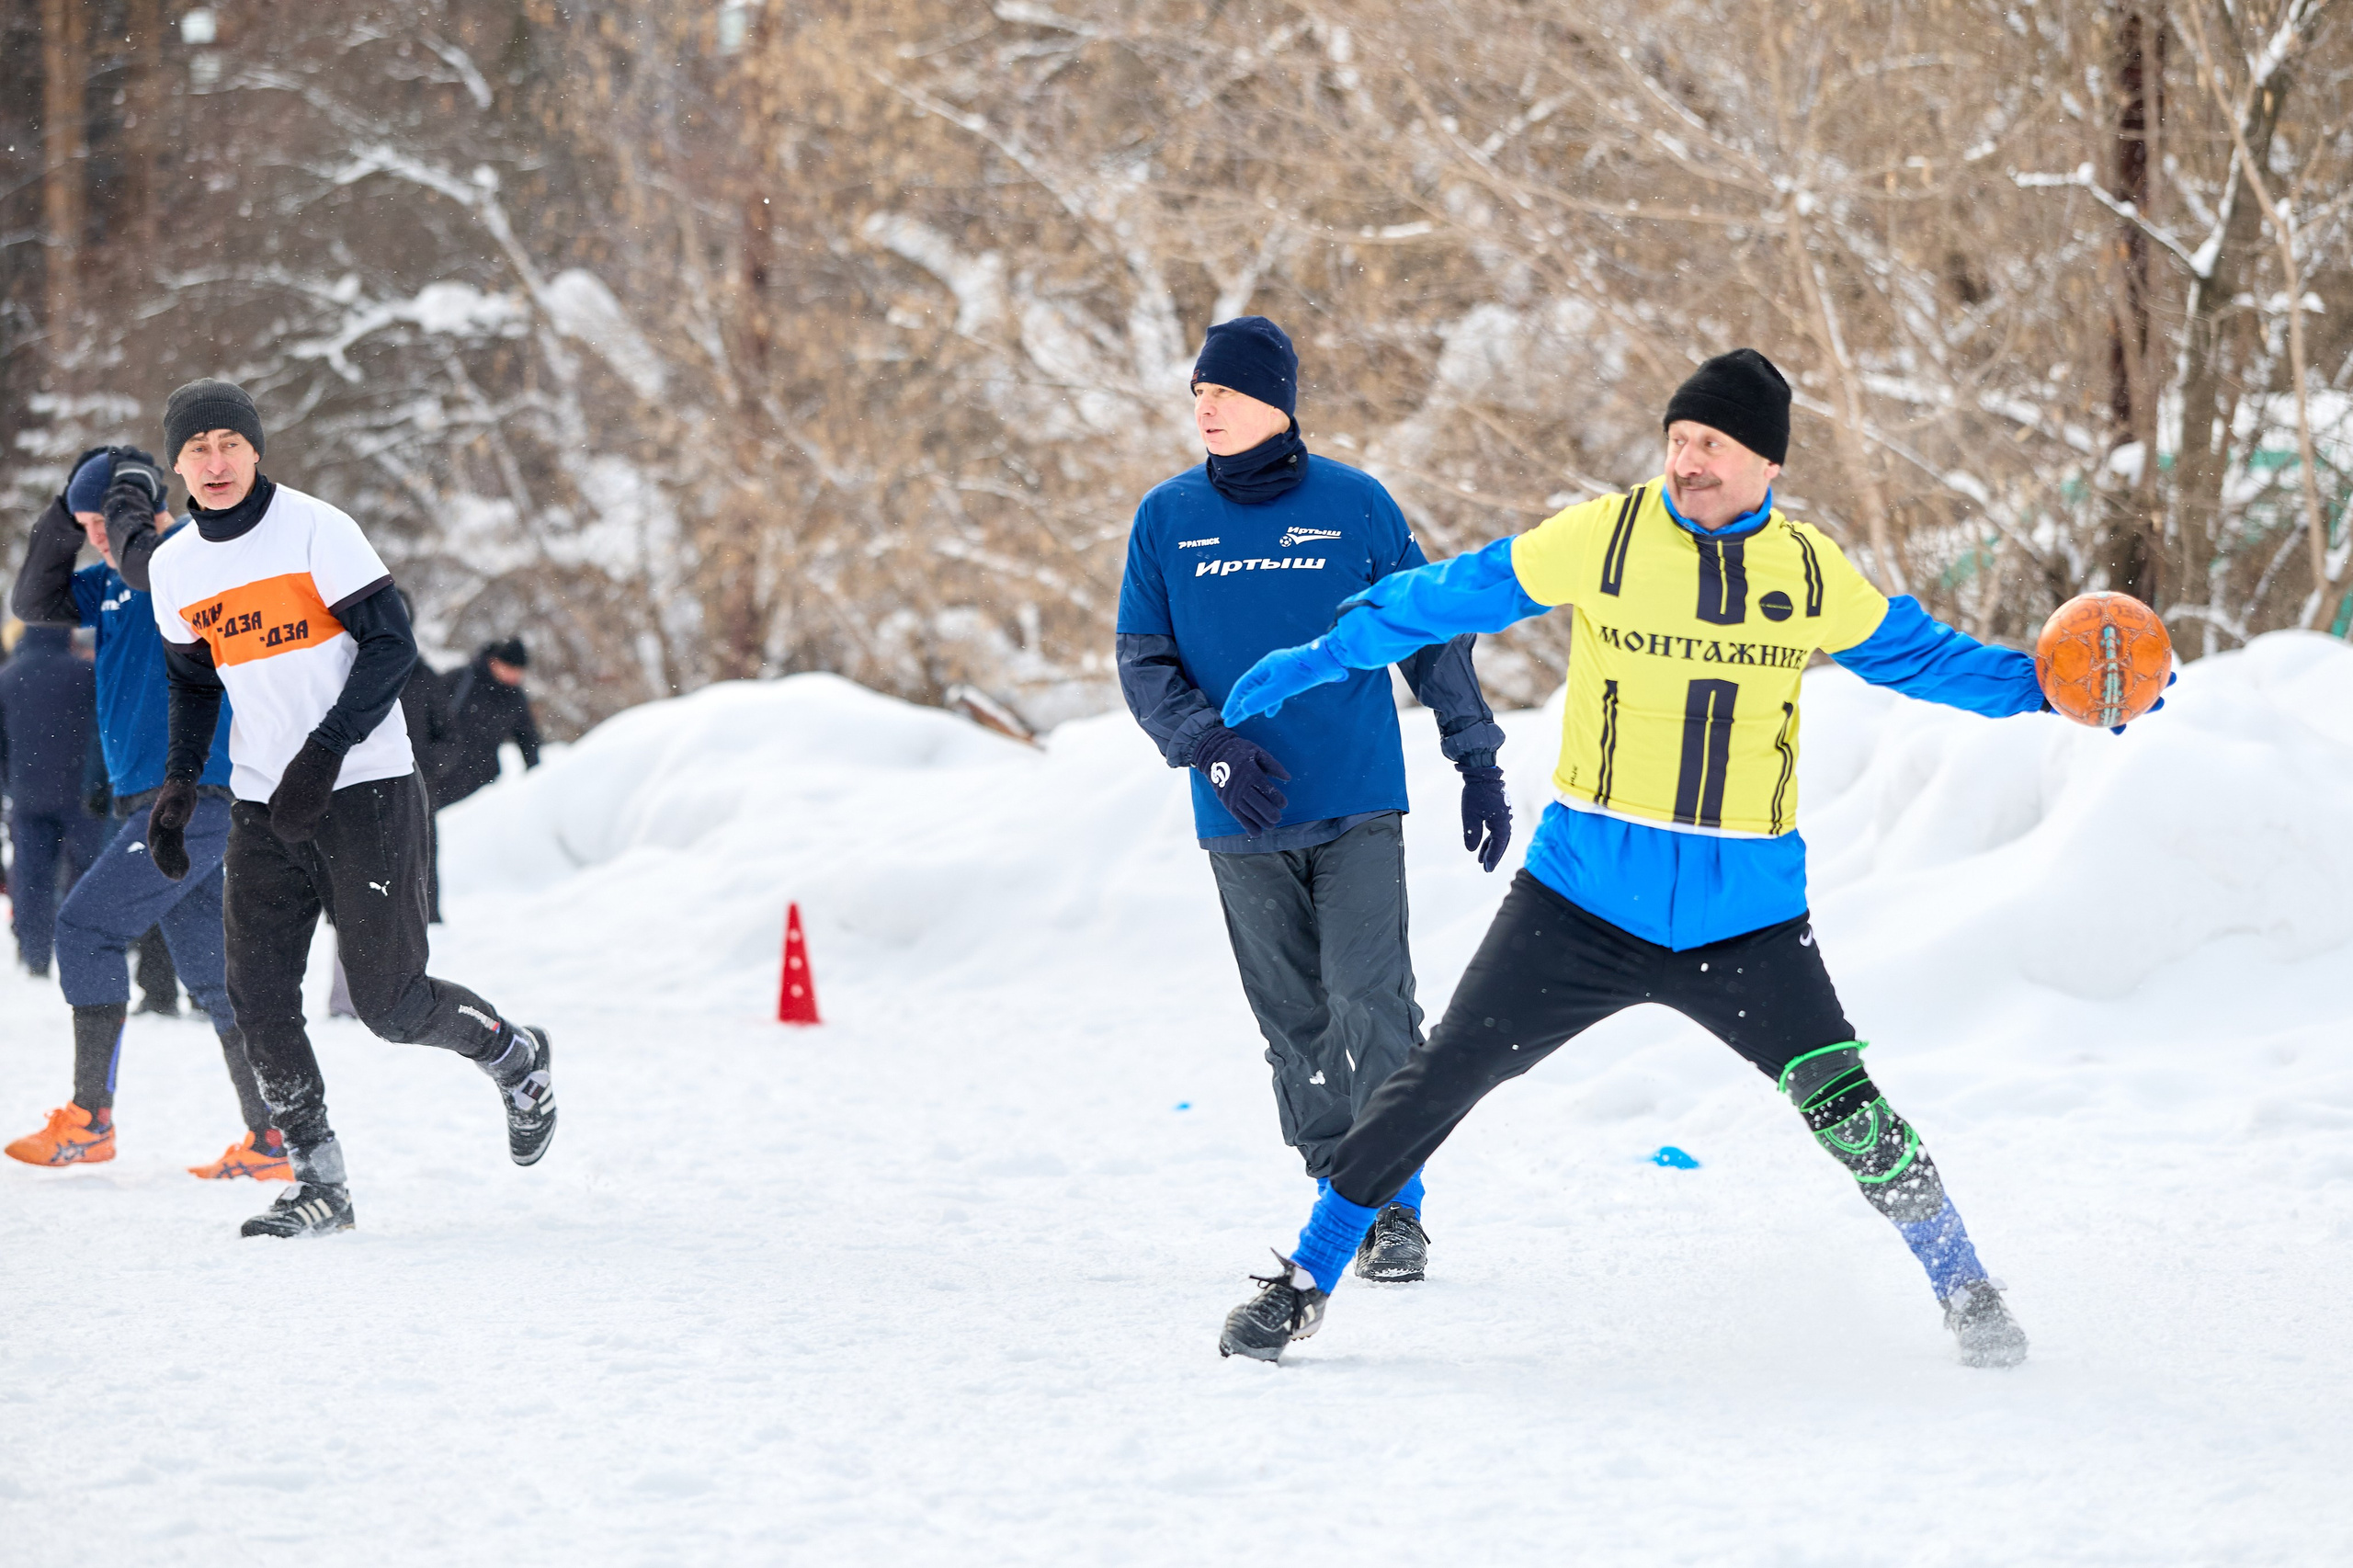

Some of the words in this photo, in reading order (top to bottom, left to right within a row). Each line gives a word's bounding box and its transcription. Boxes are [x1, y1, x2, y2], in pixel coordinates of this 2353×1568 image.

[1287, 526, 1342, 537] Иртыш
[1187, 537, 1221, 548] PATRICK
[1195, 557, 1326, 577] Иртыш
[1599, 625, 1807, 670] МОНТАЖНИК
